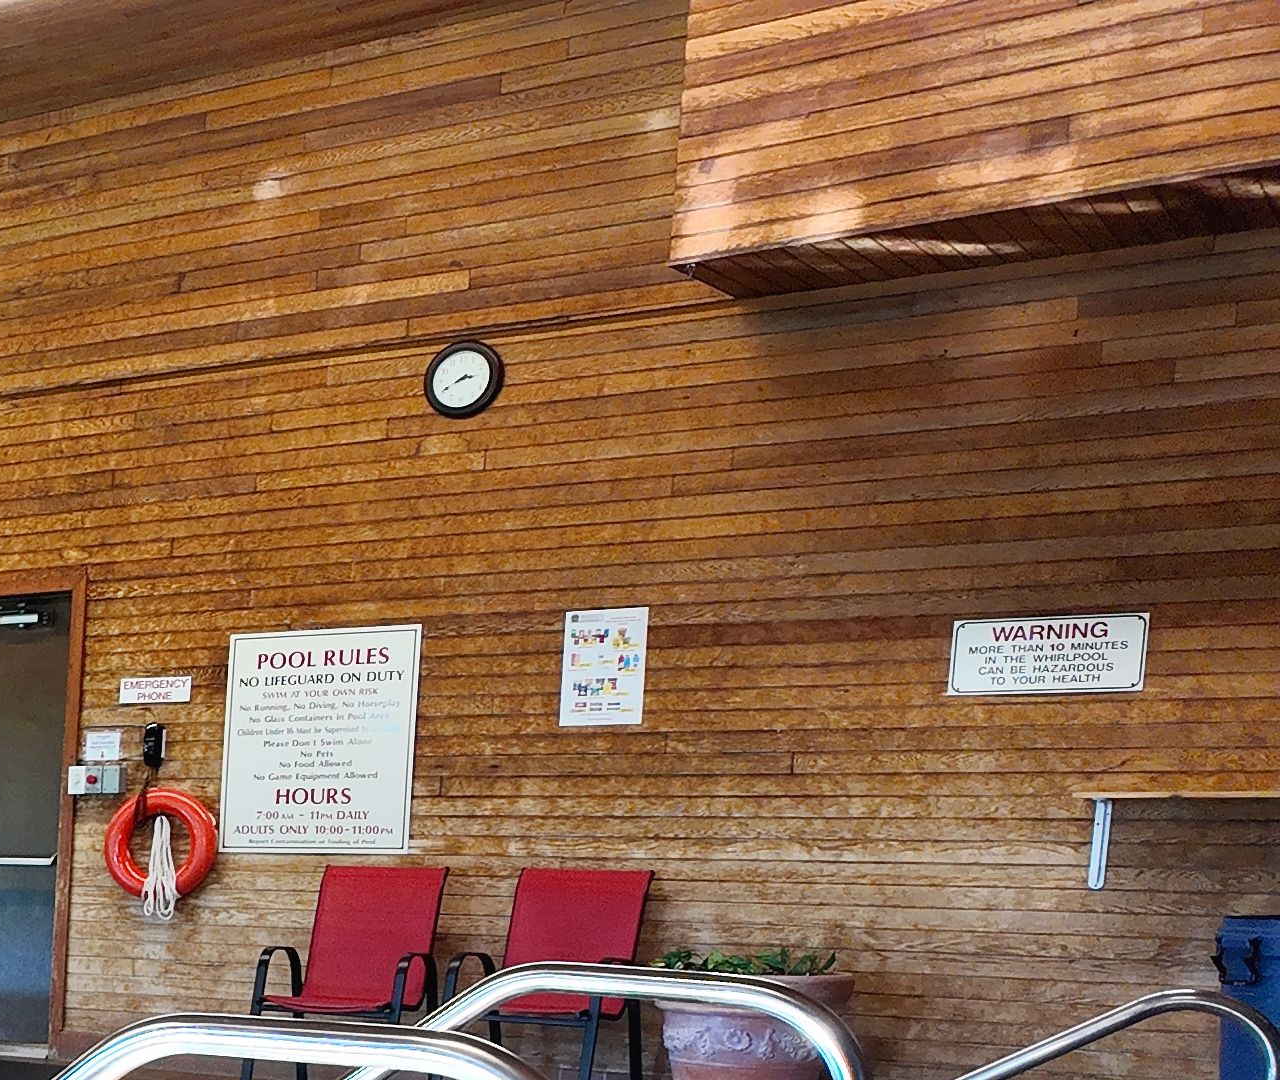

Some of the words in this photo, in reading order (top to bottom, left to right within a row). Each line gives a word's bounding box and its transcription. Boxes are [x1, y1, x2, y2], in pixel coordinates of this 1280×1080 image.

[992, 622, 1109, 641] WARNING
[968, 645, 1005, 654] MORE
[1011, 644, 1044, 653] THAN
[1049, 643, 1065, 651] 10
[1070, 640, 1129, 650] MINUTES
[257, 651, 316, 669] POOL
[323, 647, 390, 666] RULES
[984, 656, 997, 664] IN
[1002, 655, 1026, 663] THE
[1033, 652, 1109, 662] WHIRLPOOL
[978, 666, 1004, 675] CAN
[1010, 665, 1026, 674] BE
[1032, 662, 1114, 673] HAZARDOUS
[124, 679, 190, 689] EMERGENCY
[240, 676, 260, 687] NO
[264, 673, 334, 686] LIFEGUARD
[341, 672, 361, 683] ON
[367, 670, 405, 681] DUTY
[990, 677, 1006, 685] TO
[1011, 676, 1046, 684] YOUR
[1052, 674, 1101, 683] HEALTH
[137, 692, 172, 700] PHONE
[262, 691, 287, 699] SWIM
[290, 690, 300, 698] AT
[289, 714, 333, 723] Containers
[347, 712, 366, 720] Pool
[263, 740, 289, 748] Please
[320, 738, 344, 746] Swim
[295, 760, 315, 768] Food
[318, 760, 352, 768] Allowed
[268, 772, 292, 780] Game
[296, 771, 341, 782] Equipment
[343, 771, 378, 779] Allowed
[275, 788, 351, 804] HOURS
[256, 811, 279, 820] 7:00
[336, 810, 370, 820] DAILY
[233, 825, 275, 834] ADULTS
[279, 825, 309, 834] ONLY
